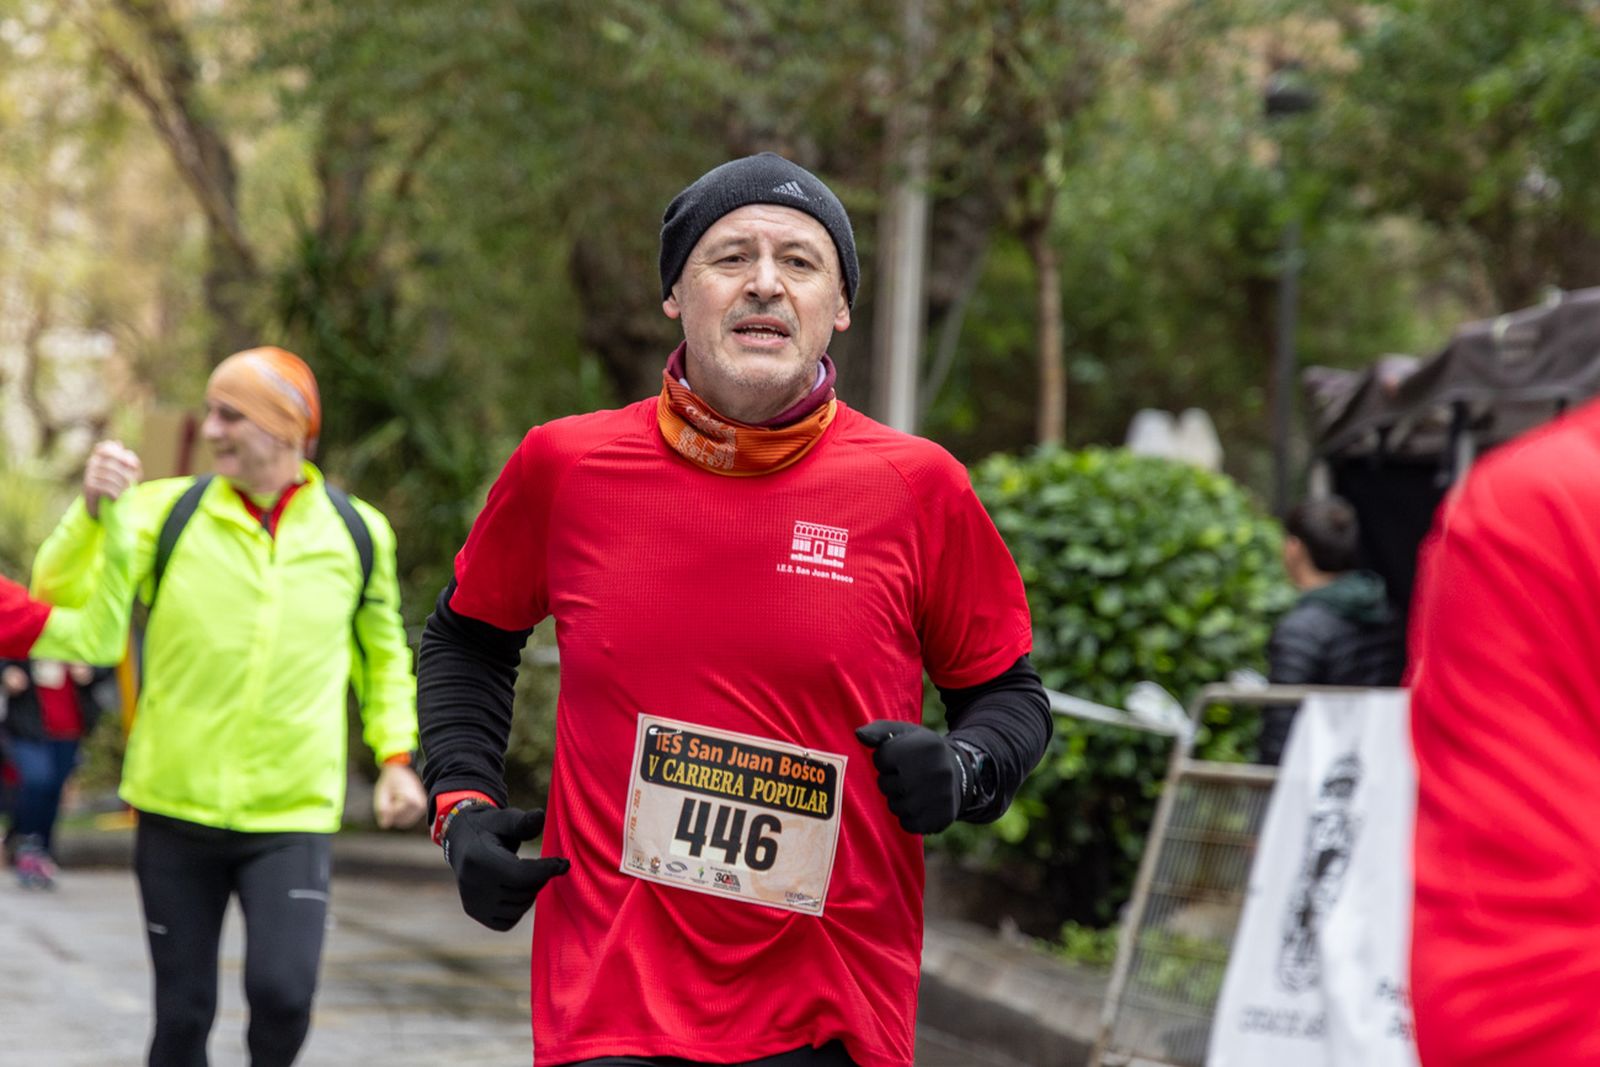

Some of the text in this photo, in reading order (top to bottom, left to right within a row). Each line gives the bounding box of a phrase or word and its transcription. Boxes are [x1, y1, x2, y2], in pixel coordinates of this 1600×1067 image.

[776, 563, 854, 584] I.E.S. San Juan Bosco
[648, 754, 828, 815] V CARRERA POPULAR
[656, 733, 826, 784] IES San Juan Bosco
[674, 797, 782, 872] 446
